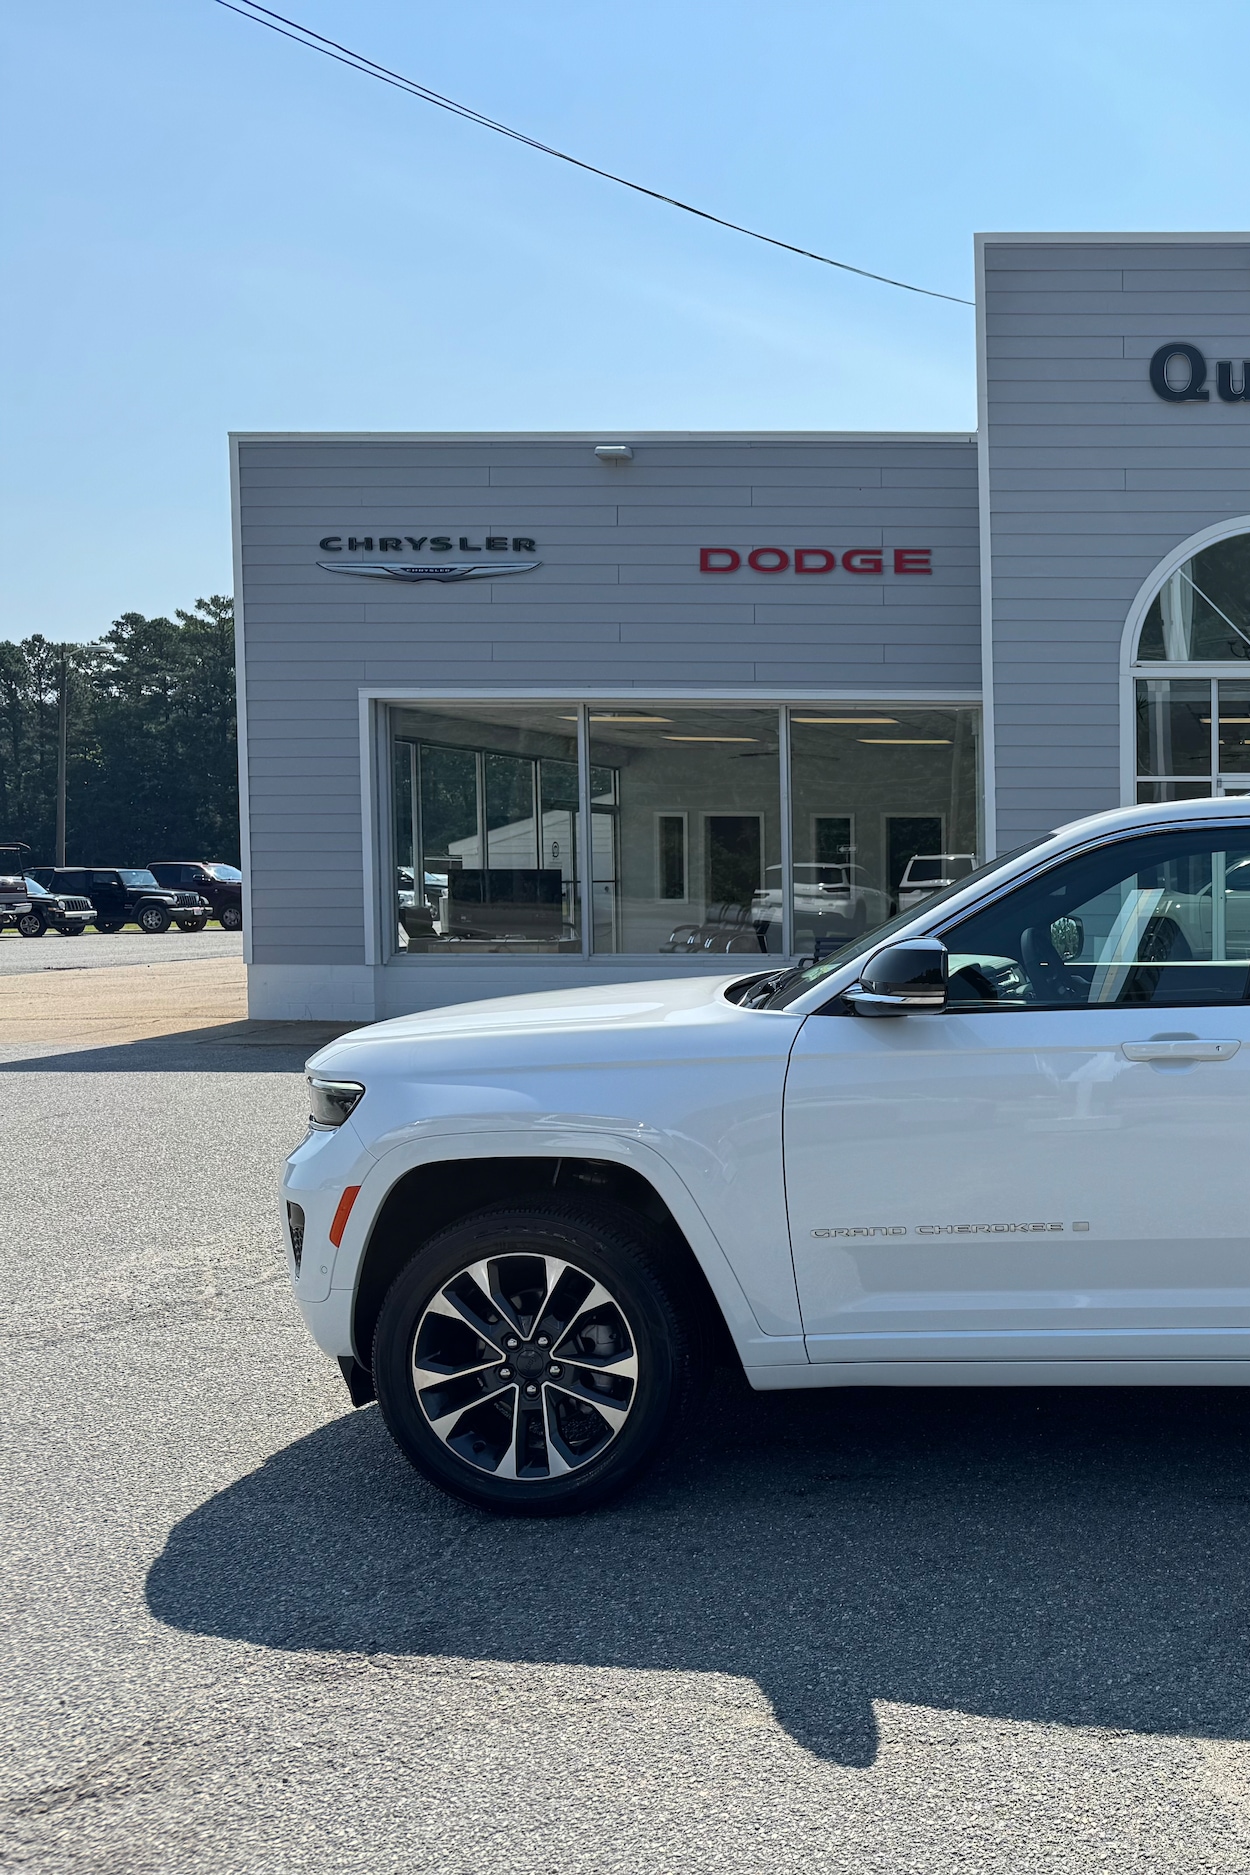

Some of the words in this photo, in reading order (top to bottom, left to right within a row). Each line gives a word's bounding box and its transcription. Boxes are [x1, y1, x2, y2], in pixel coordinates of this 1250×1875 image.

[319, 536, 536, 551] CHRYSLER
[700, 548, 932, 575] DODGE
[810, 1226, 907, 1239] GRAND
[915, 1222, 1065, 1235] CHEROKEE
